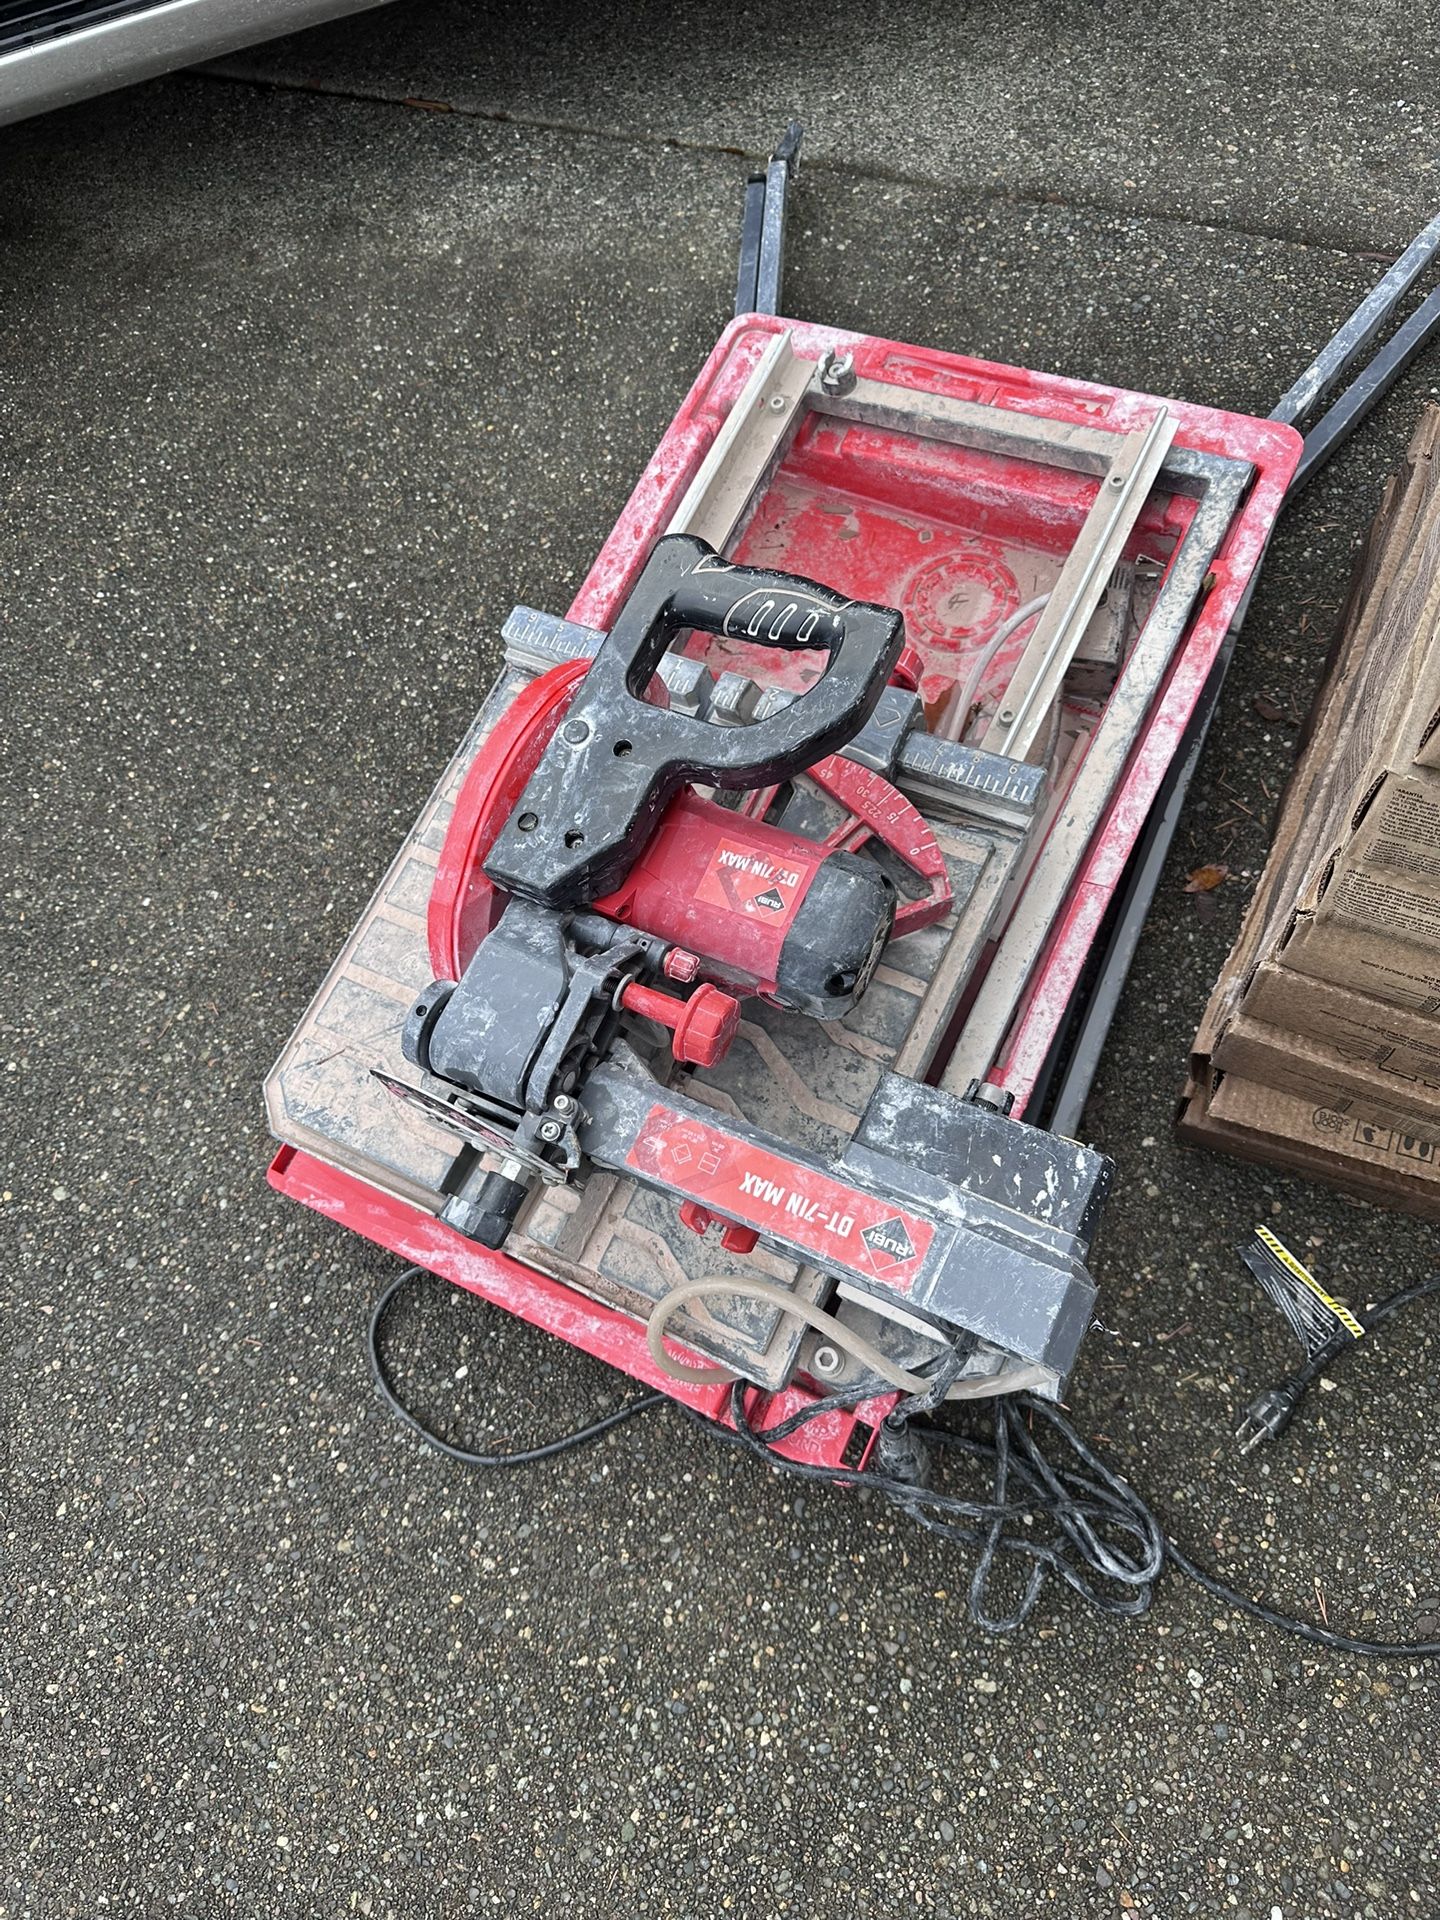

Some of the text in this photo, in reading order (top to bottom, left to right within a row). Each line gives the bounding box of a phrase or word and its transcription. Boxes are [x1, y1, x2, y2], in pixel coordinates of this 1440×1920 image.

[527, 612, 537, 622] 6
[675, 659, 683, 669] 1
[768, 688, 779, 700] 2
[818, 768, 834, 780] 45
[857, 785, 870, 797] 30
[1395, 788, 1423, 798] ARANTIA
[860, 800, 882, 818] 22.5
[886, 811, 900, 824] 15
[718, 849, 799, 887] DT7IN MAX
[756, 895, 782, 910] RUBI
[737, 1170, 855, 1238] DT-7IN MAX
[866, 1229, 910, 1258] RUBI
